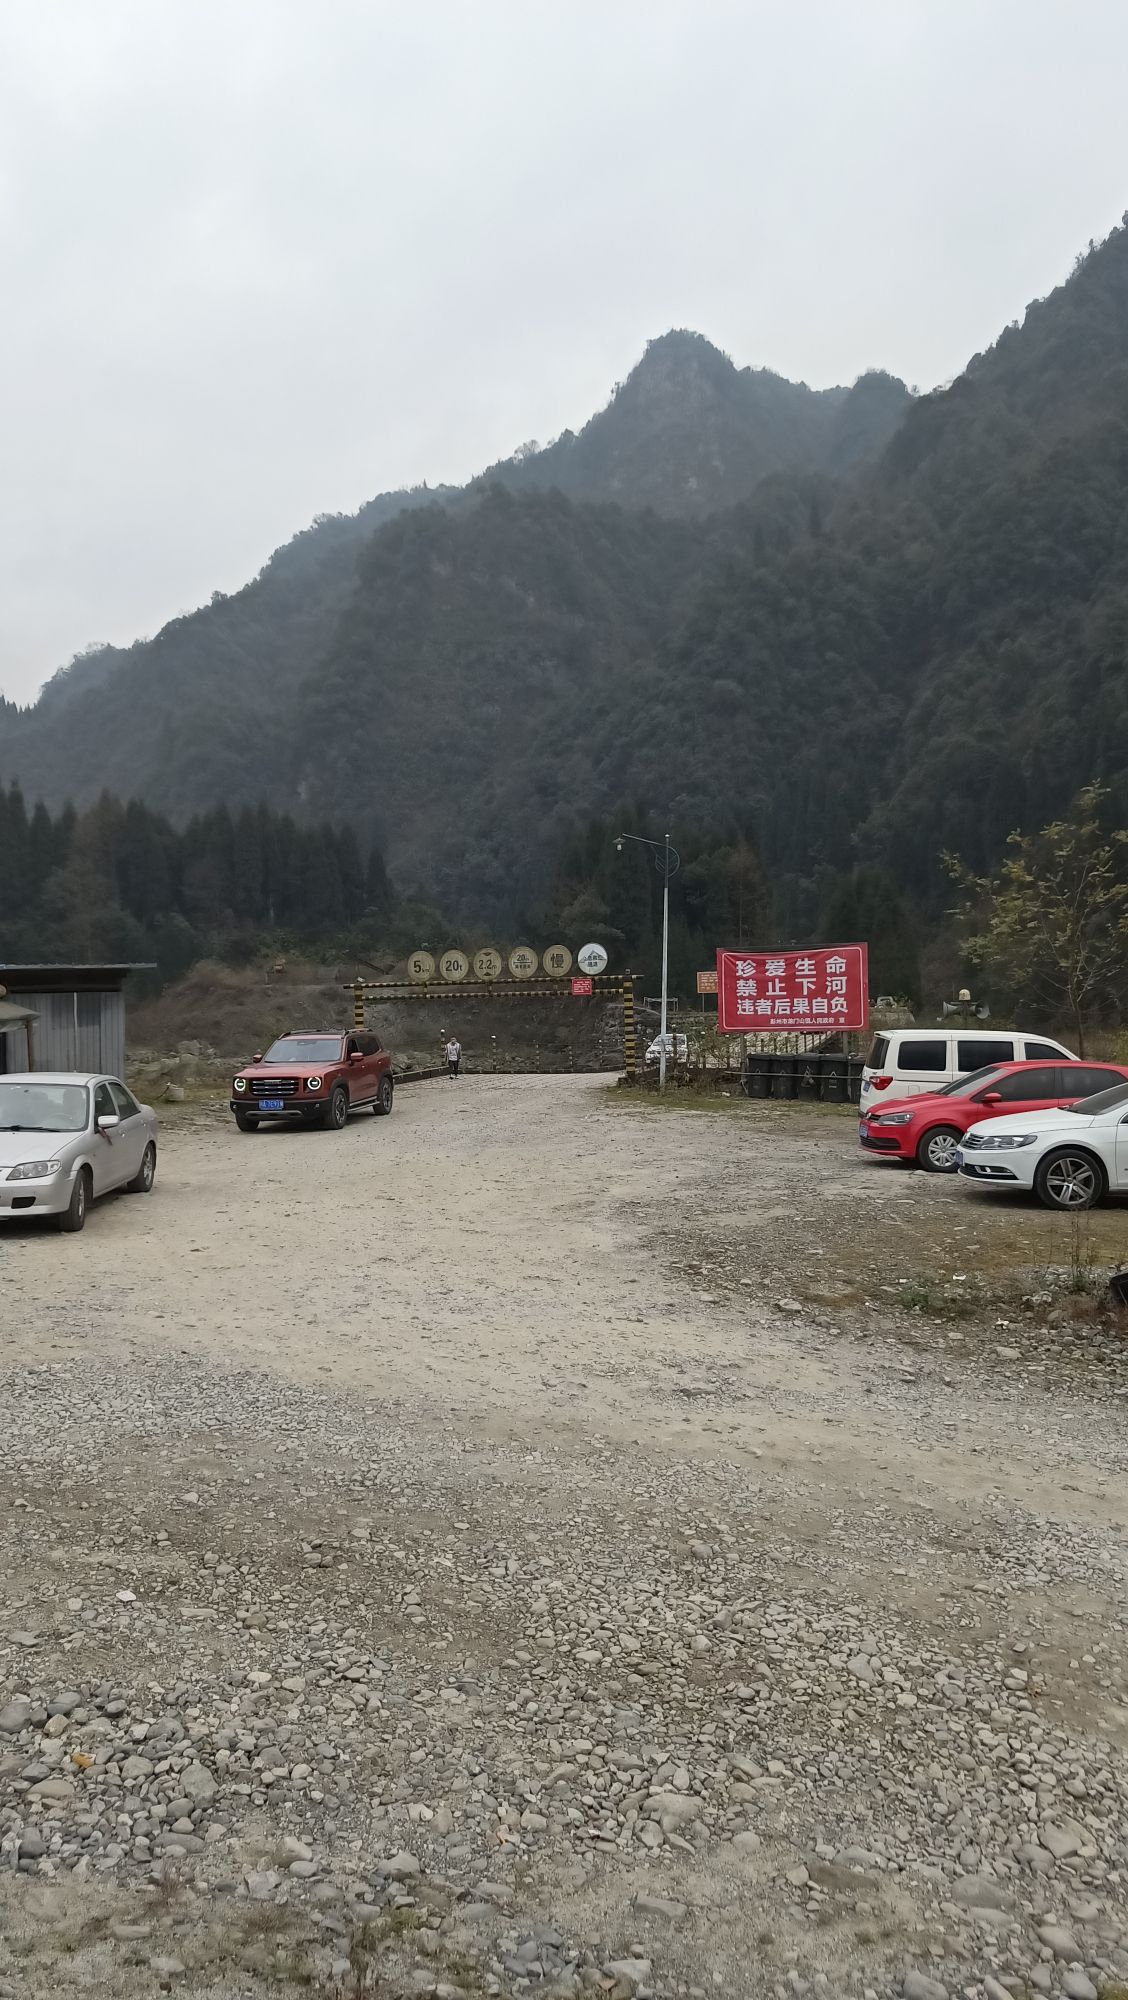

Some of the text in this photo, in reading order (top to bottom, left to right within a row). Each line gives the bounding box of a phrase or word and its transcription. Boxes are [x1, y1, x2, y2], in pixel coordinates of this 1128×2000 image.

[445, 960, 463, 972] 20t
[550, 953, 564, 969] 慢
[735, 955, 847, 977] 珍爱生命
[736, 976, 848, 997] 禁止下河
[736, 996, 849, 1015] 违者后果自负
